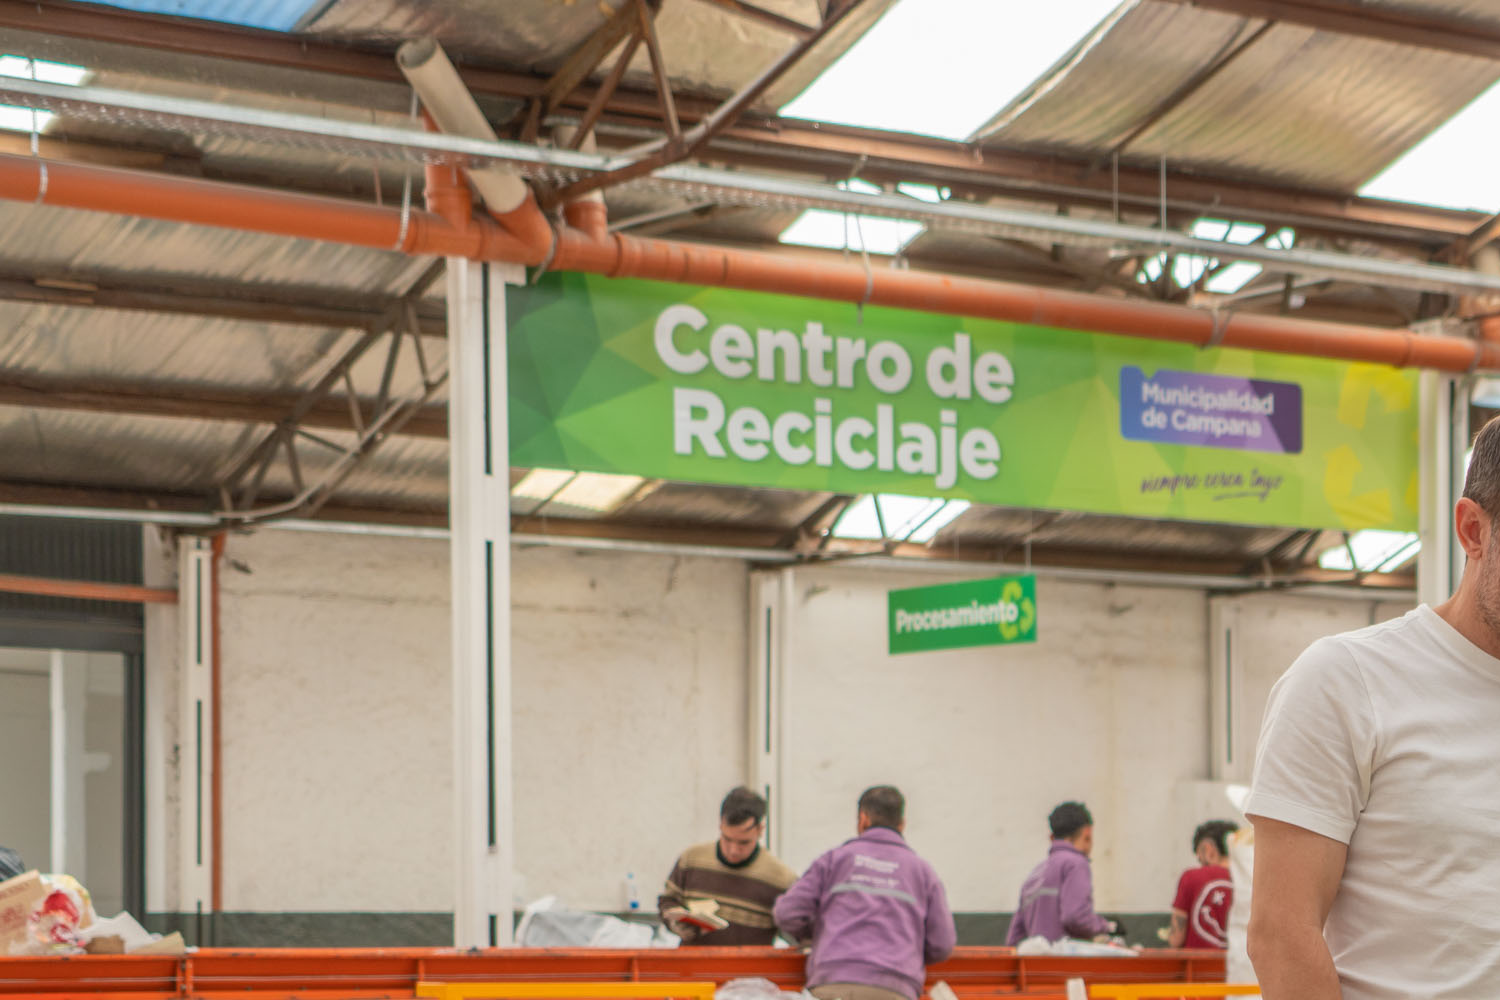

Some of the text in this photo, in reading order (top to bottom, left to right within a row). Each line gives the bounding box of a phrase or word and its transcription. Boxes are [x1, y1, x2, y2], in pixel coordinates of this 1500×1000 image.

[654, 304, 1015, 404] Centro de
[1142, 382, 1275, 416] Municipalidad
[673, 387, 1001, 490] Reciclaje
[1141, 406, 1263, 438] de Campana
[896, 599, 1019, 634] Procesamiento
